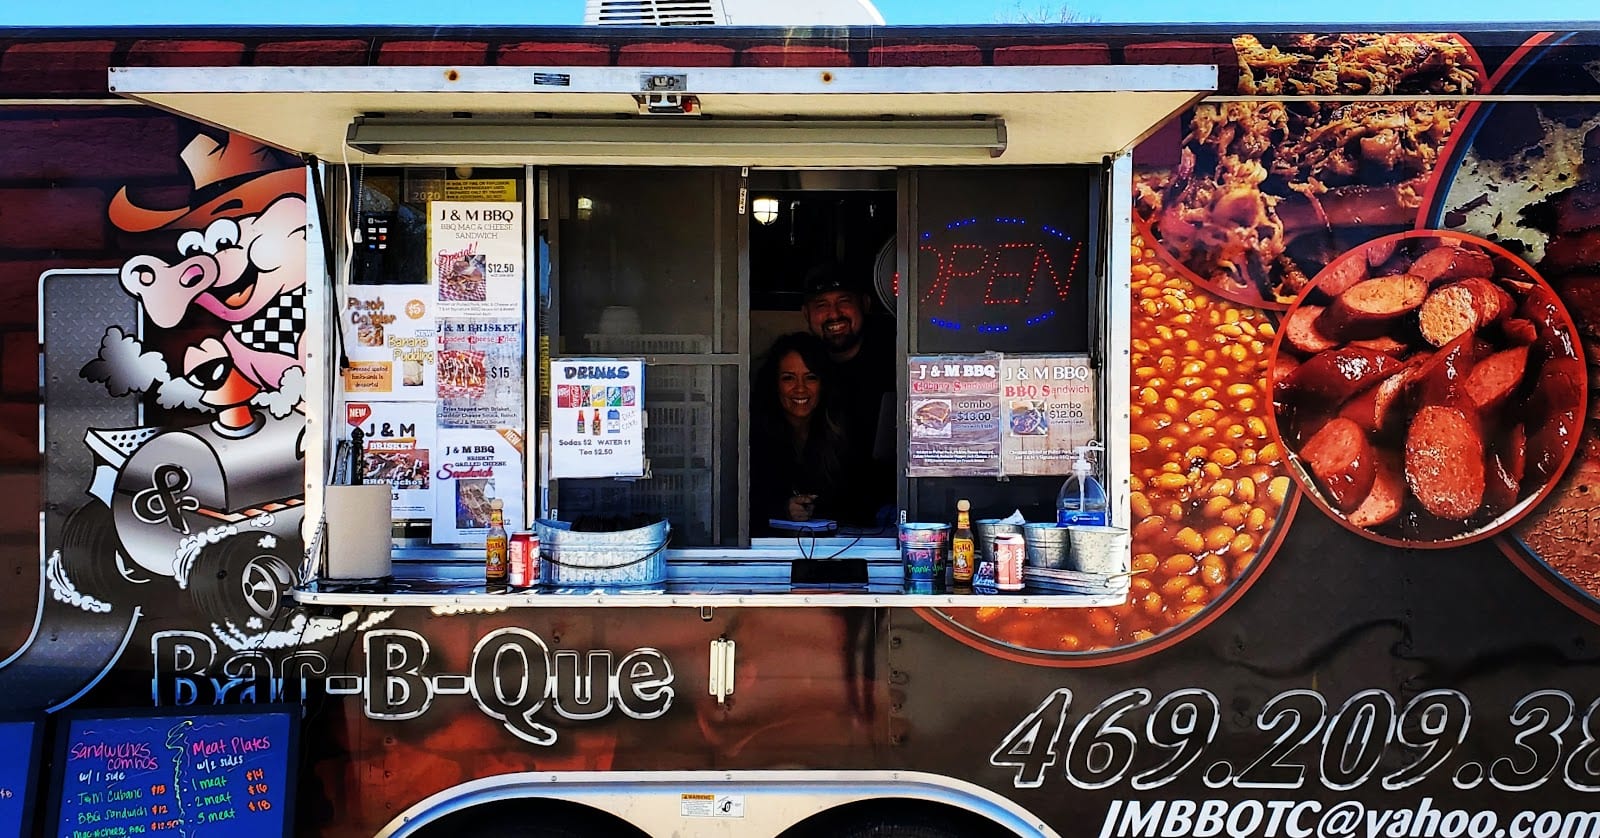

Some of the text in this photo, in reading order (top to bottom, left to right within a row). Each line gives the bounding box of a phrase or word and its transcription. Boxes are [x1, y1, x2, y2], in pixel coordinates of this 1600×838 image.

[414, 192, 440, 200] 2020
[440, 209, 514, 223] J & M BBQ
[488, 264, 514, 273] $12.50
[408, 303, 421, 314] $5
[436, 324, 518, 332] J & M BRISKET
[388, 334, 428, 348] Banana
[393, 348, 434, 365] Pudding
[919, 364, 996, 380] J & M BBQ
[1006, 366, 1088, 381] J & M BBQ
[1005, 384, 1090, 400] BBQ Sandwich
[958, 400, 992, 408] combo
[350, 408, 366, 418] NEW
[957, 412, 991, 421] $13.00
[1050, 410, 1083, 419] $12.00
[366, 422, 416, 437] J & M
[446, 446, 495, 456] J & M BBQ
[594, 448, 613, 456] $2.50
[436, 463, 494, 480] Sandwich
[132, 463, 200, 534] &
[152, 628, 676, 746] Bar-B-Que
[192, 736, 270, 758] Meat Plates
[220, 754, 244, 767] sides
[105, 772, 126, 782] side
[192, 768, 264, 791] 1 meat $14
[194, 784, 268, 807] 2 meat $16
[152, 805, 168, 815] $12
[208, 808, 236, 822] meat
[248, 800, 271, 812] $18
